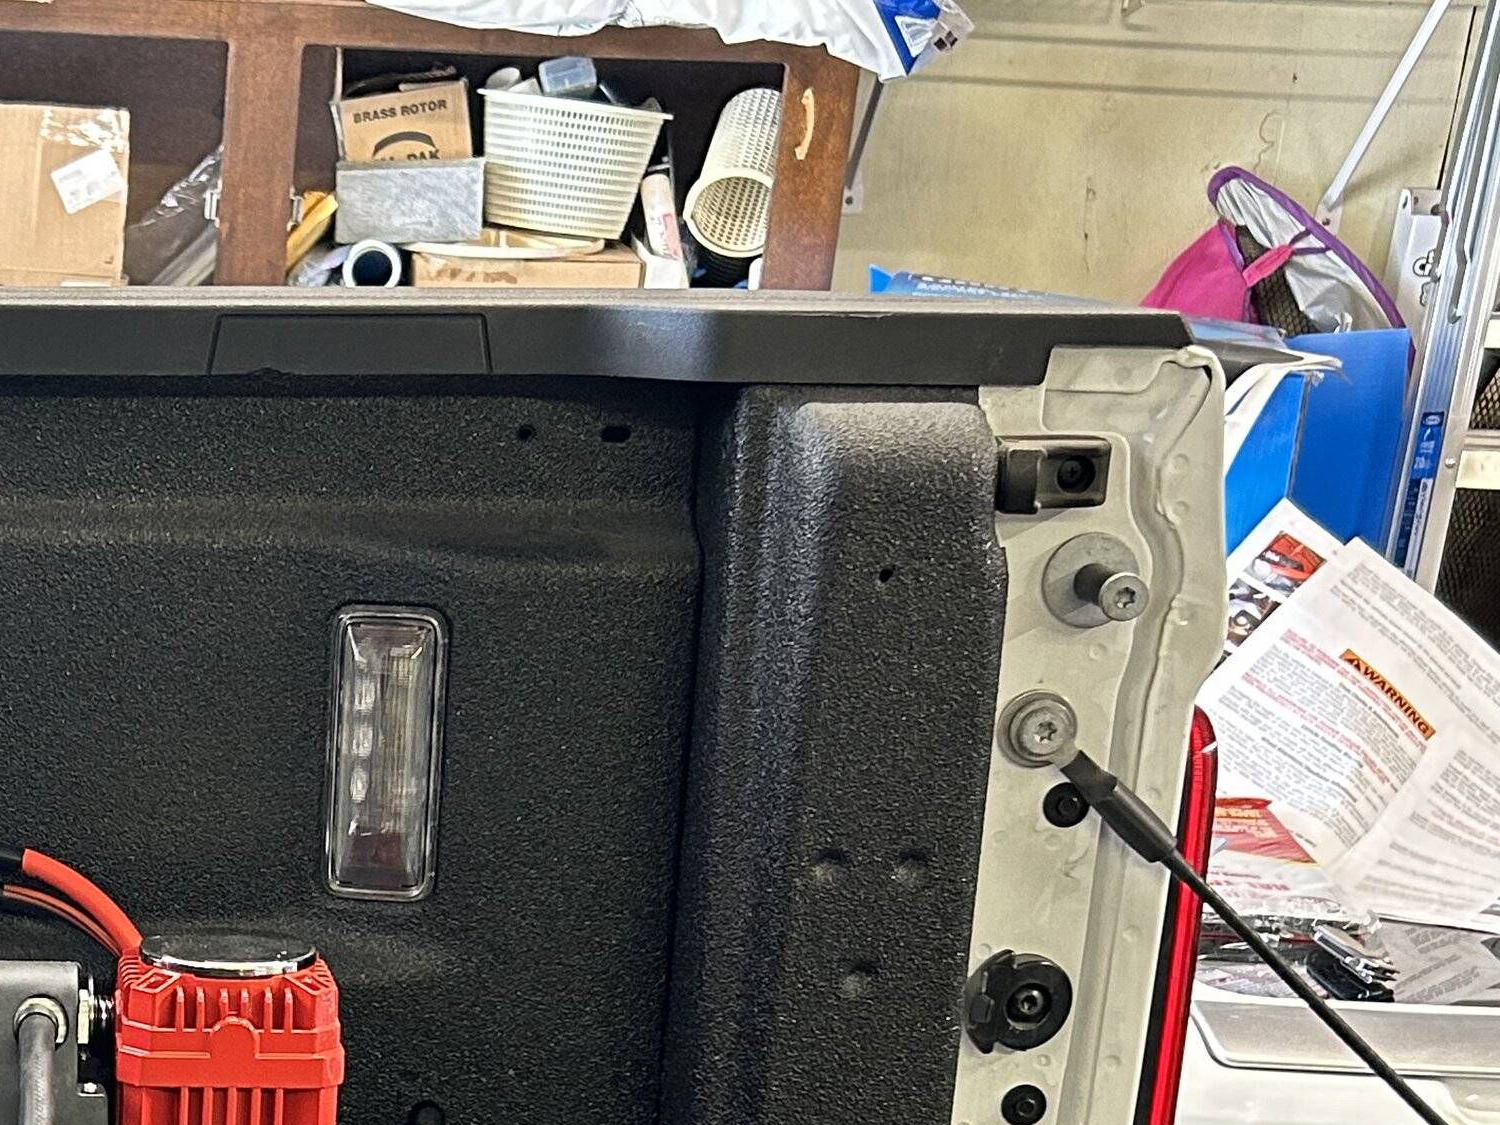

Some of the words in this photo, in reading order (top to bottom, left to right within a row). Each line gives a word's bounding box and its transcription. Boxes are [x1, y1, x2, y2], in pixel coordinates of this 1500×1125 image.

[353, 107, 398, 124] BRASS
[401, 99, 448, 117] ROTOR
[1363, 666, 1429, 734] WARNING
